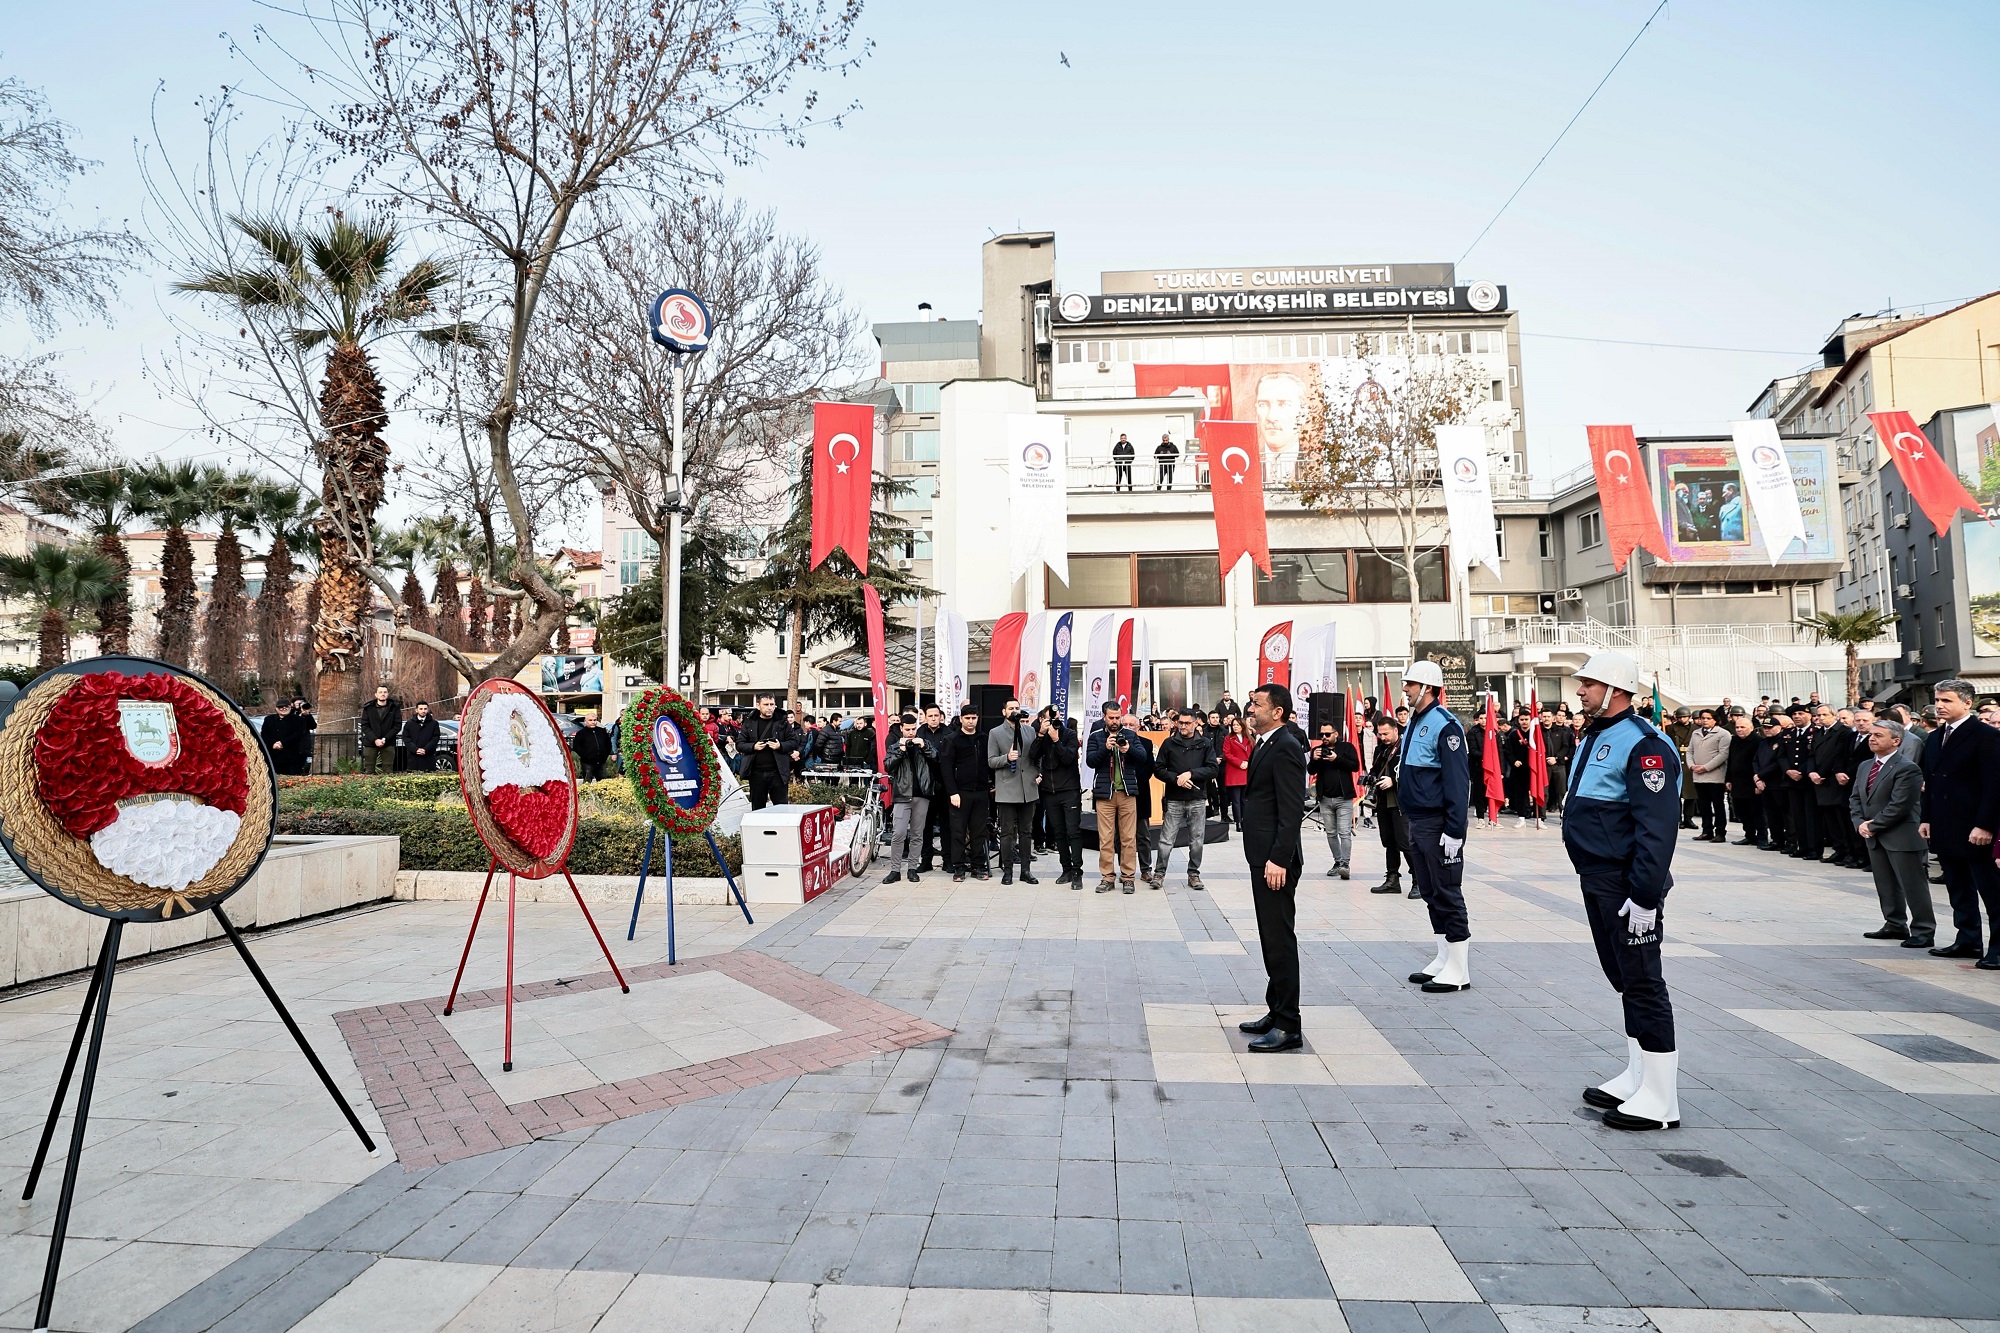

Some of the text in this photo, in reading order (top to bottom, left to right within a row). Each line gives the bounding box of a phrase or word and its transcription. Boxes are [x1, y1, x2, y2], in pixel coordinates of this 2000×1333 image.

[1154, 265, 1391, 288] TÜRKİYE CUMHURİYETİ
[1103, 286, 1455, 313] DENİZLİ BÜYÜKŞEHİR BELEDİYESİ
[1793, 477, 1816, 486] K'ÜN
[1266, 666, 1275, 685] POR
[814, 812, 822, 842] 1
[813, 865, 821, 891] 2
[1627, 934, 1657, 945] ZABITA
